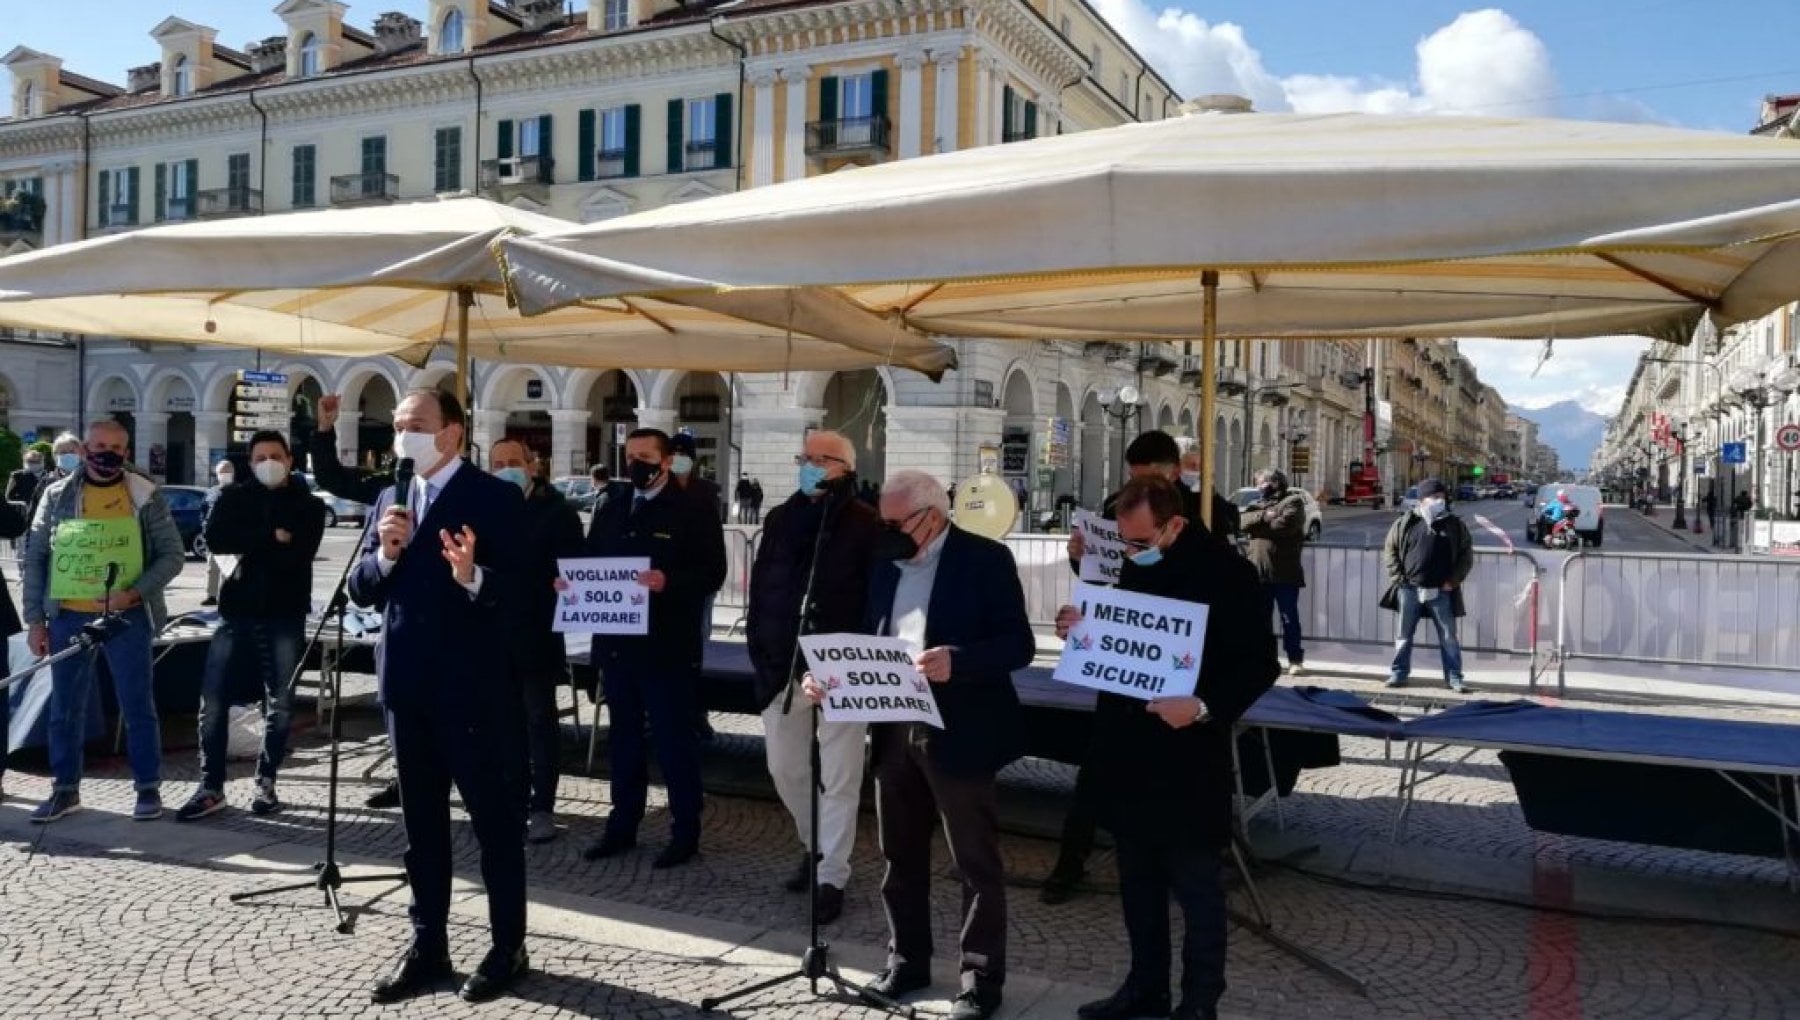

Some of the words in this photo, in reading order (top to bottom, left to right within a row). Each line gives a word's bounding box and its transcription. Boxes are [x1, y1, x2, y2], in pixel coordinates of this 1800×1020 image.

[584, 590, 623, 604] SOLO
[562, 611, 641, 624] LAVORARE!
[1081, 601, 1087, 617] I
[1094, 603, 1192, 637] MERCATI
[812, 646, 914, 666] VOGLIAMO
[1099, 634, 1163, 662] SONO
[847, 671, 901, 687] SOLO
[1081, 661, 1167, 694] SICURI!
[829, 695, 933, 715] LAVORARE!
